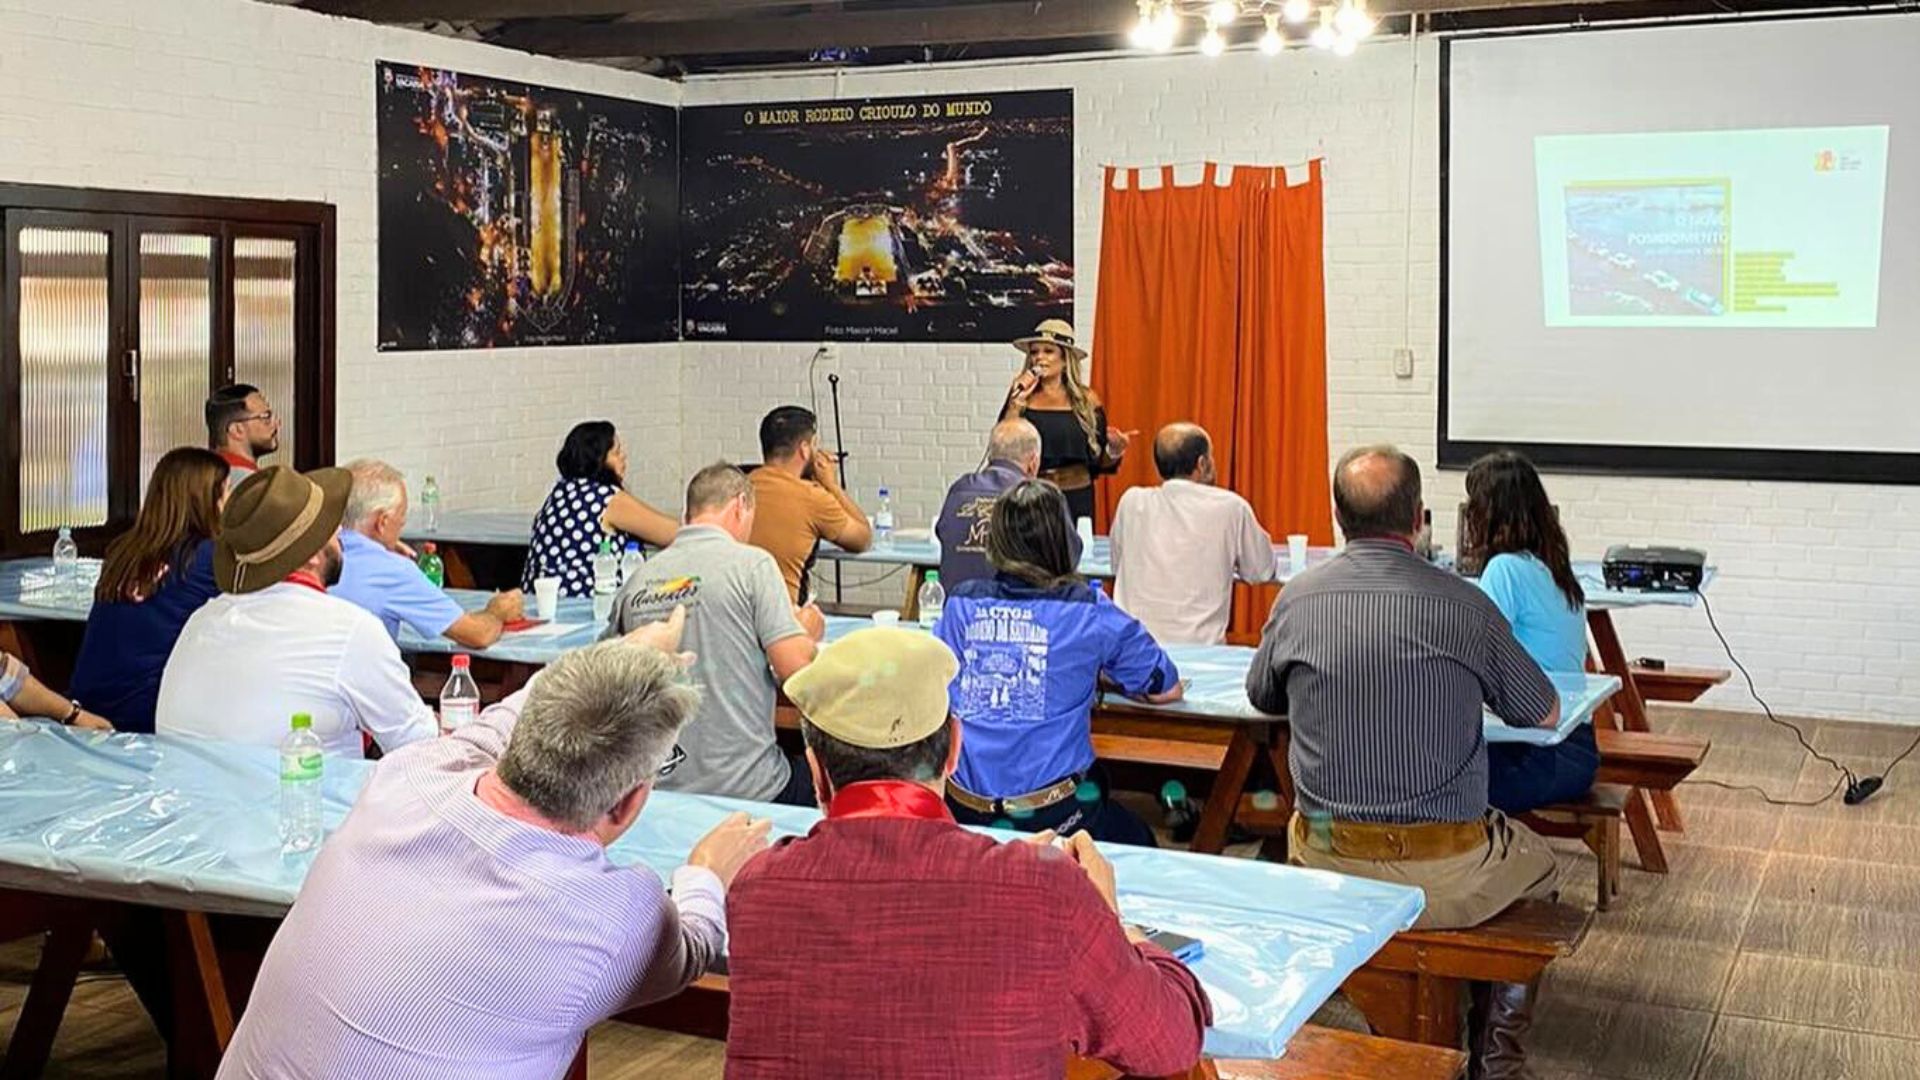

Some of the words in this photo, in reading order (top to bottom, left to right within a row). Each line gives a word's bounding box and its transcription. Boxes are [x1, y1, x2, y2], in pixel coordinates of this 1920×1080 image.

[744, 111, 754, 125] O
[759, 109, 799, 124] MAIOR
[805, 107, 854, 123] RODEIO
[859, 104, 917, 121] CRIOULO
[923, 103, 940, 118] DO
[946, 100, 992, 117] MUNDO
